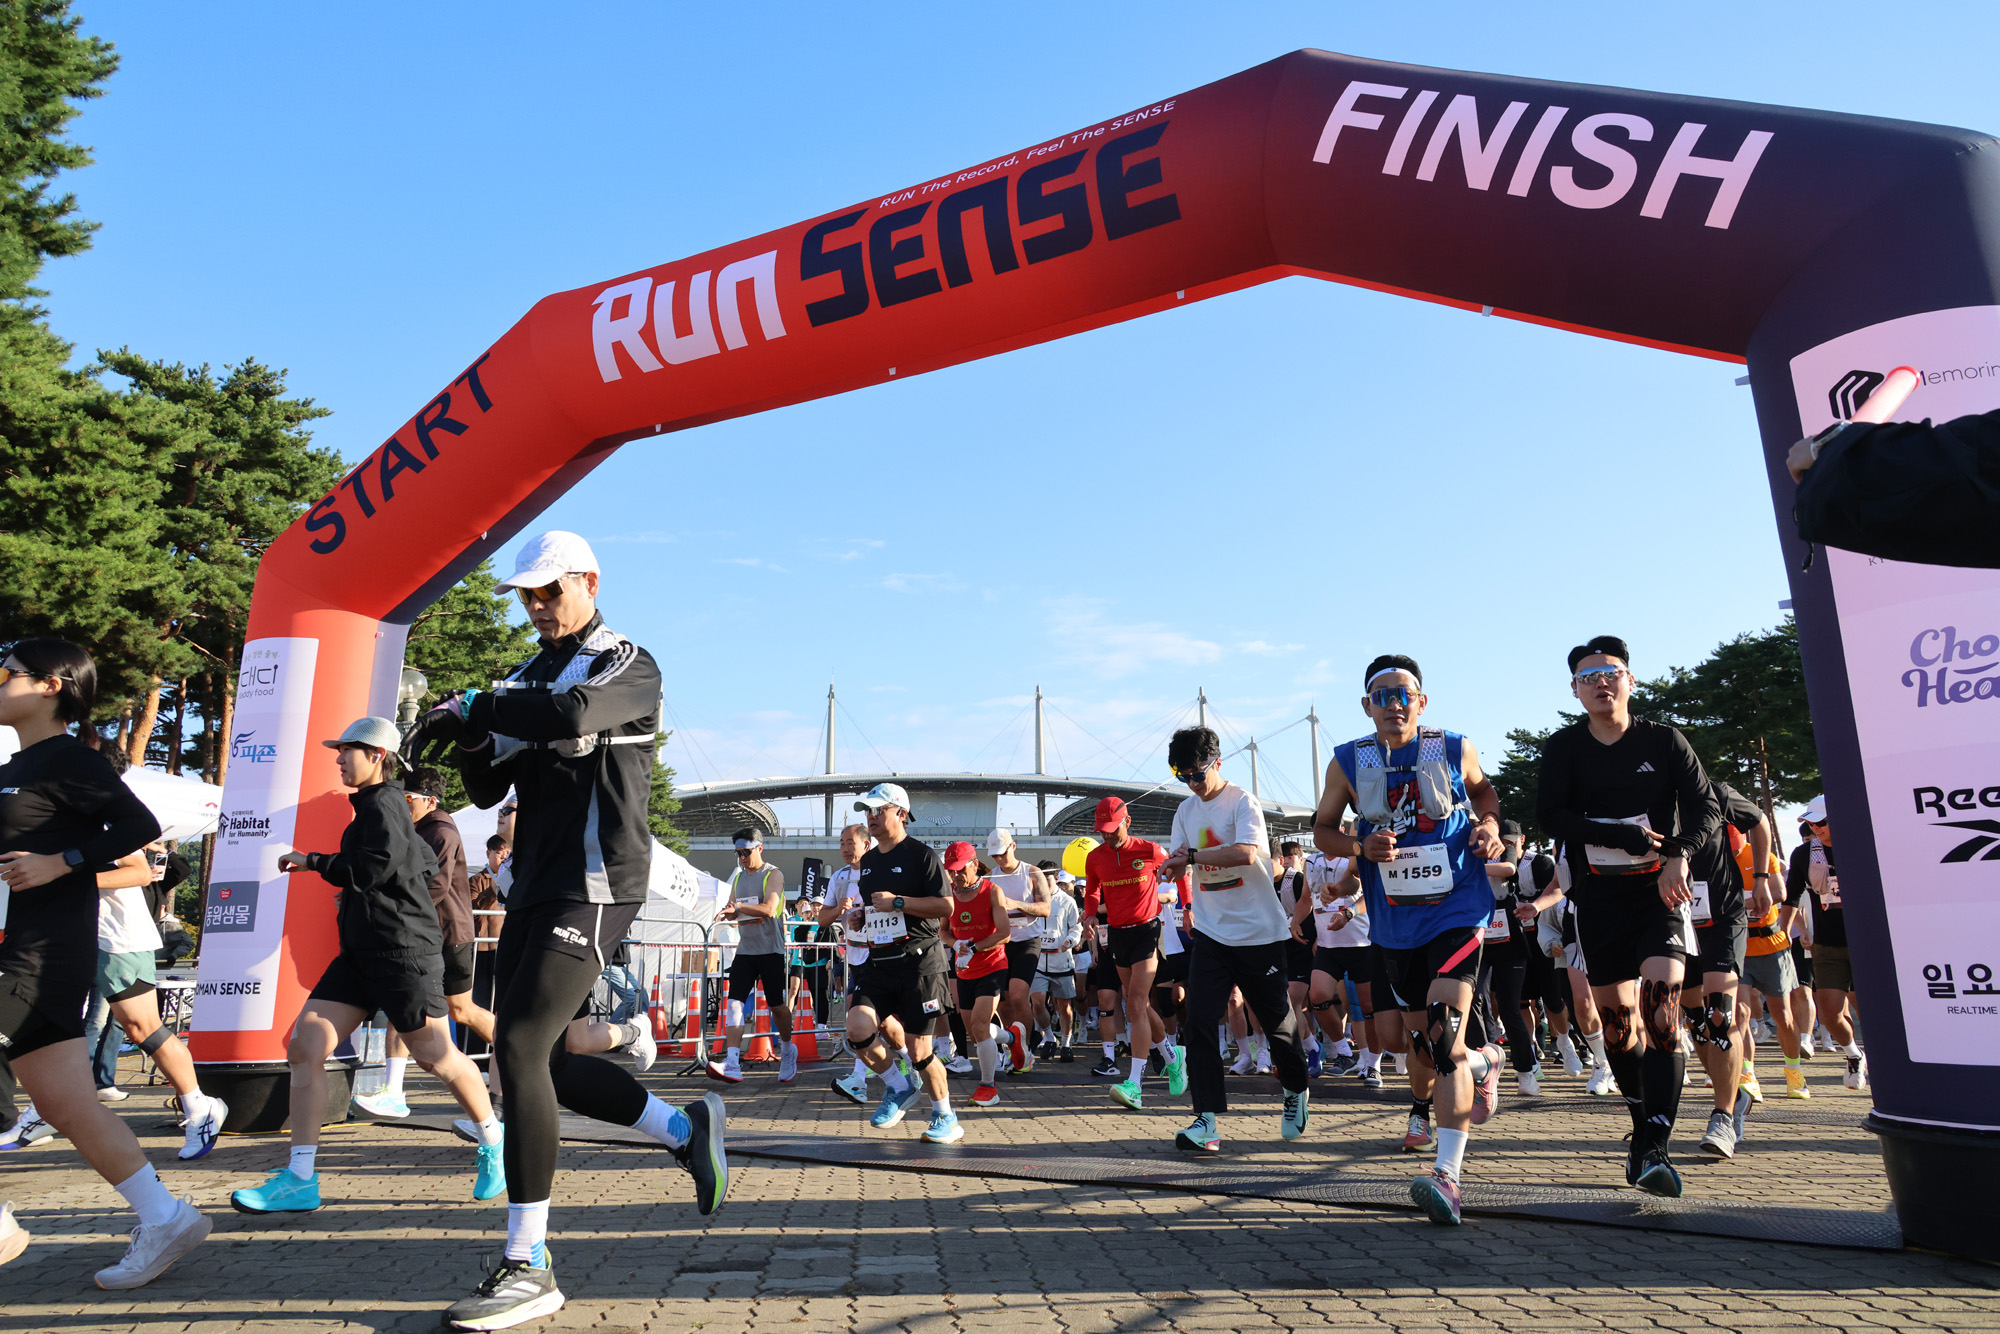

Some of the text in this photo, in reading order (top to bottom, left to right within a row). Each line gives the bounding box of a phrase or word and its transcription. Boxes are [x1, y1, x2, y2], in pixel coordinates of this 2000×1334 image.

[880, 100, 1176, 208] RUN The Record, Feel The SENSE
[1312, 81, 1774, 229] FINISH
[305, 352, 493, 554] START
[1910, 626, 2000, 667] Cho
[241, 664, 278, 688] 대디
[254, 688, 274, 697] food
[239, 744, 277, 763] 피죤
[230, 817, 270, 829] Habitat
[237, 829, 269, 838] Humanity
[1389, 865, 1442, 880] M 1559
[206, 904, 250, 927] 동원샘물
[874, 917, 898, 929] 1113
[553, 927, 570, 939] RUN
[570, 934, 588, 946] CLUB
[195, 982, 261, 995] OMAN SENSE
[1923, 963, 2000, 999] 일요
[1947, 1006, 1998, 1014] REALTIME
